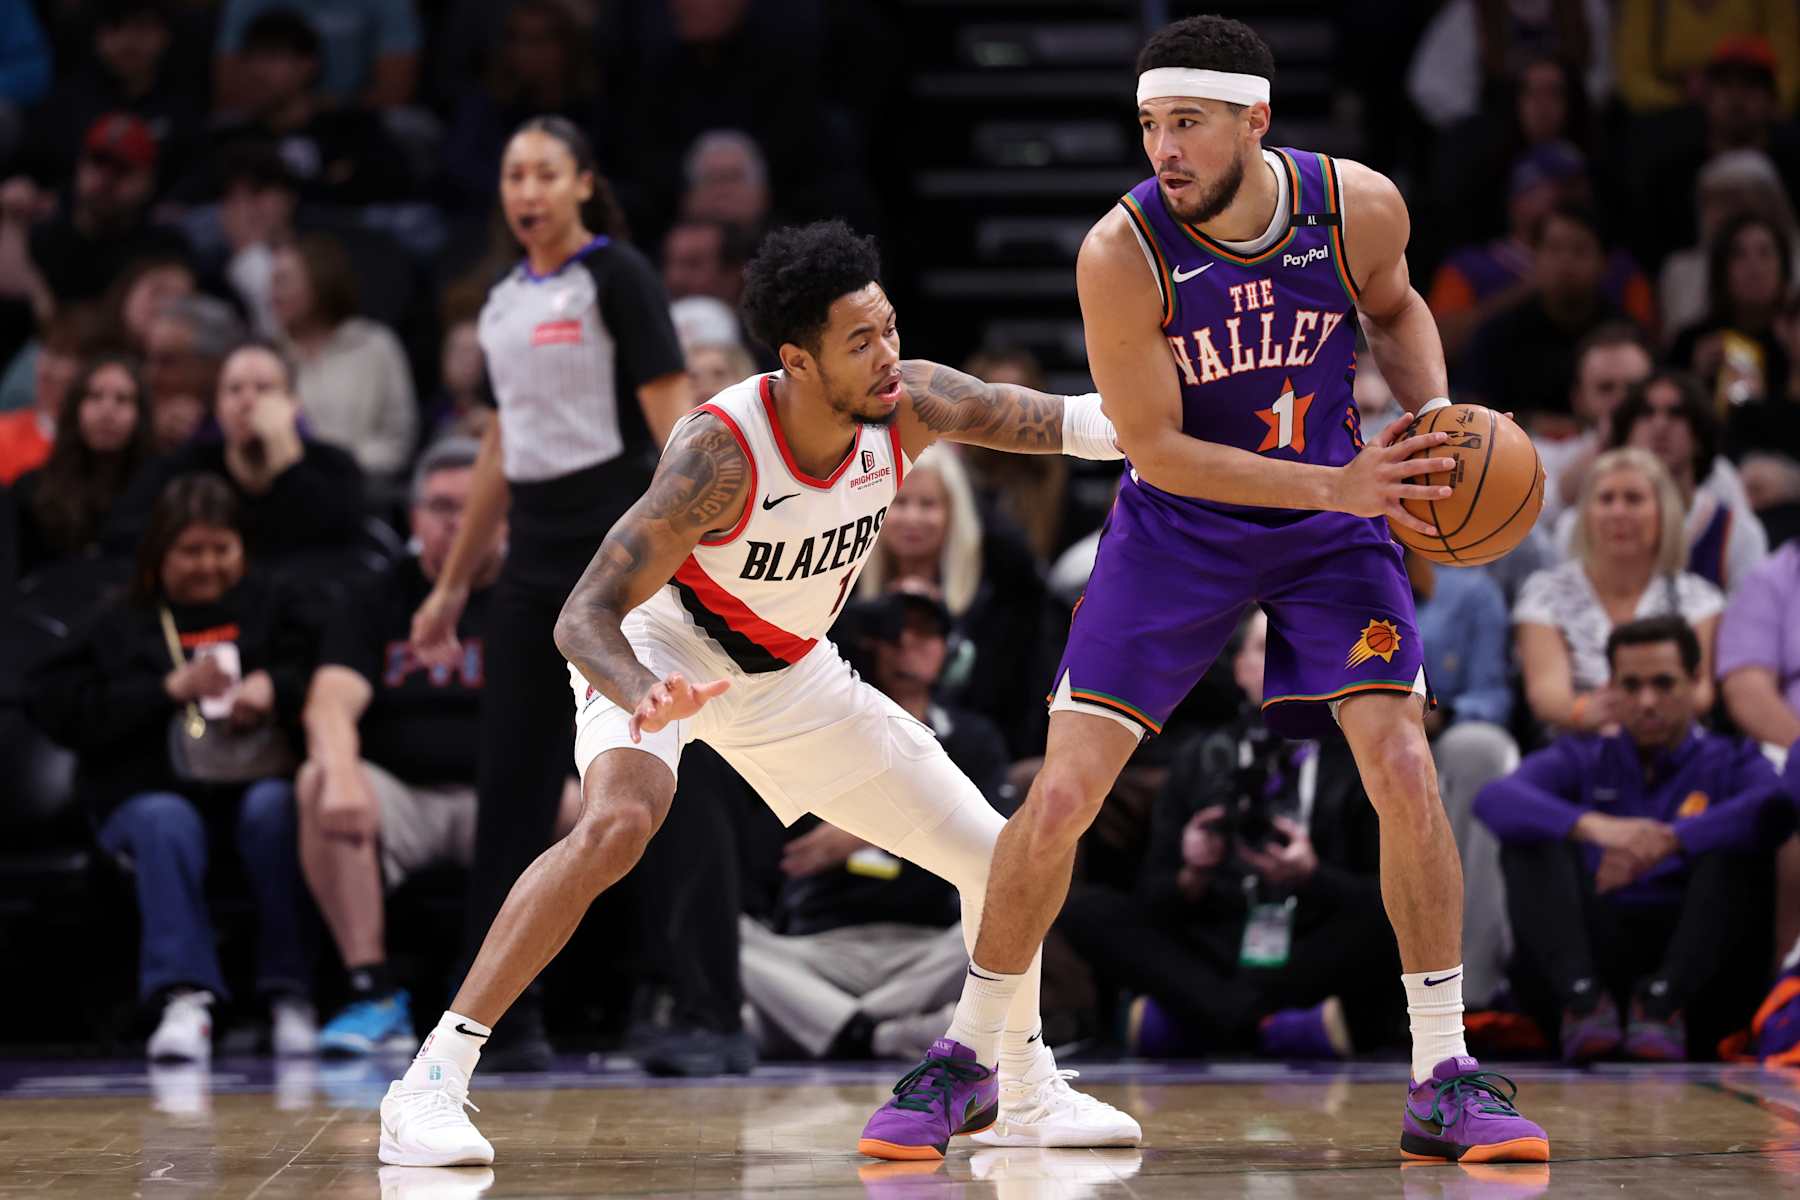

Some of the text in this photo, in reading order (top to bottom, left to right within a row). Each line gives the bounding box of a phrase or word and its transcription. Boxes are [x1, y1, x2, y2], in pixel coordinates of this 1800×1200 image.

[1307, 215, 1318, 226] AL
[1282, 244, 1329, 269] PayPal
[1229, 278, 1275, 313] THE
[1167, 309, 1344, 387] VALLEY
[1272, 390, 1295, 450] 1
[850, 466, 892, 489] BRIGHTSIDE
[739, 506, 888, 582] BLAZERS
[828, 564, 857, 617] 1
